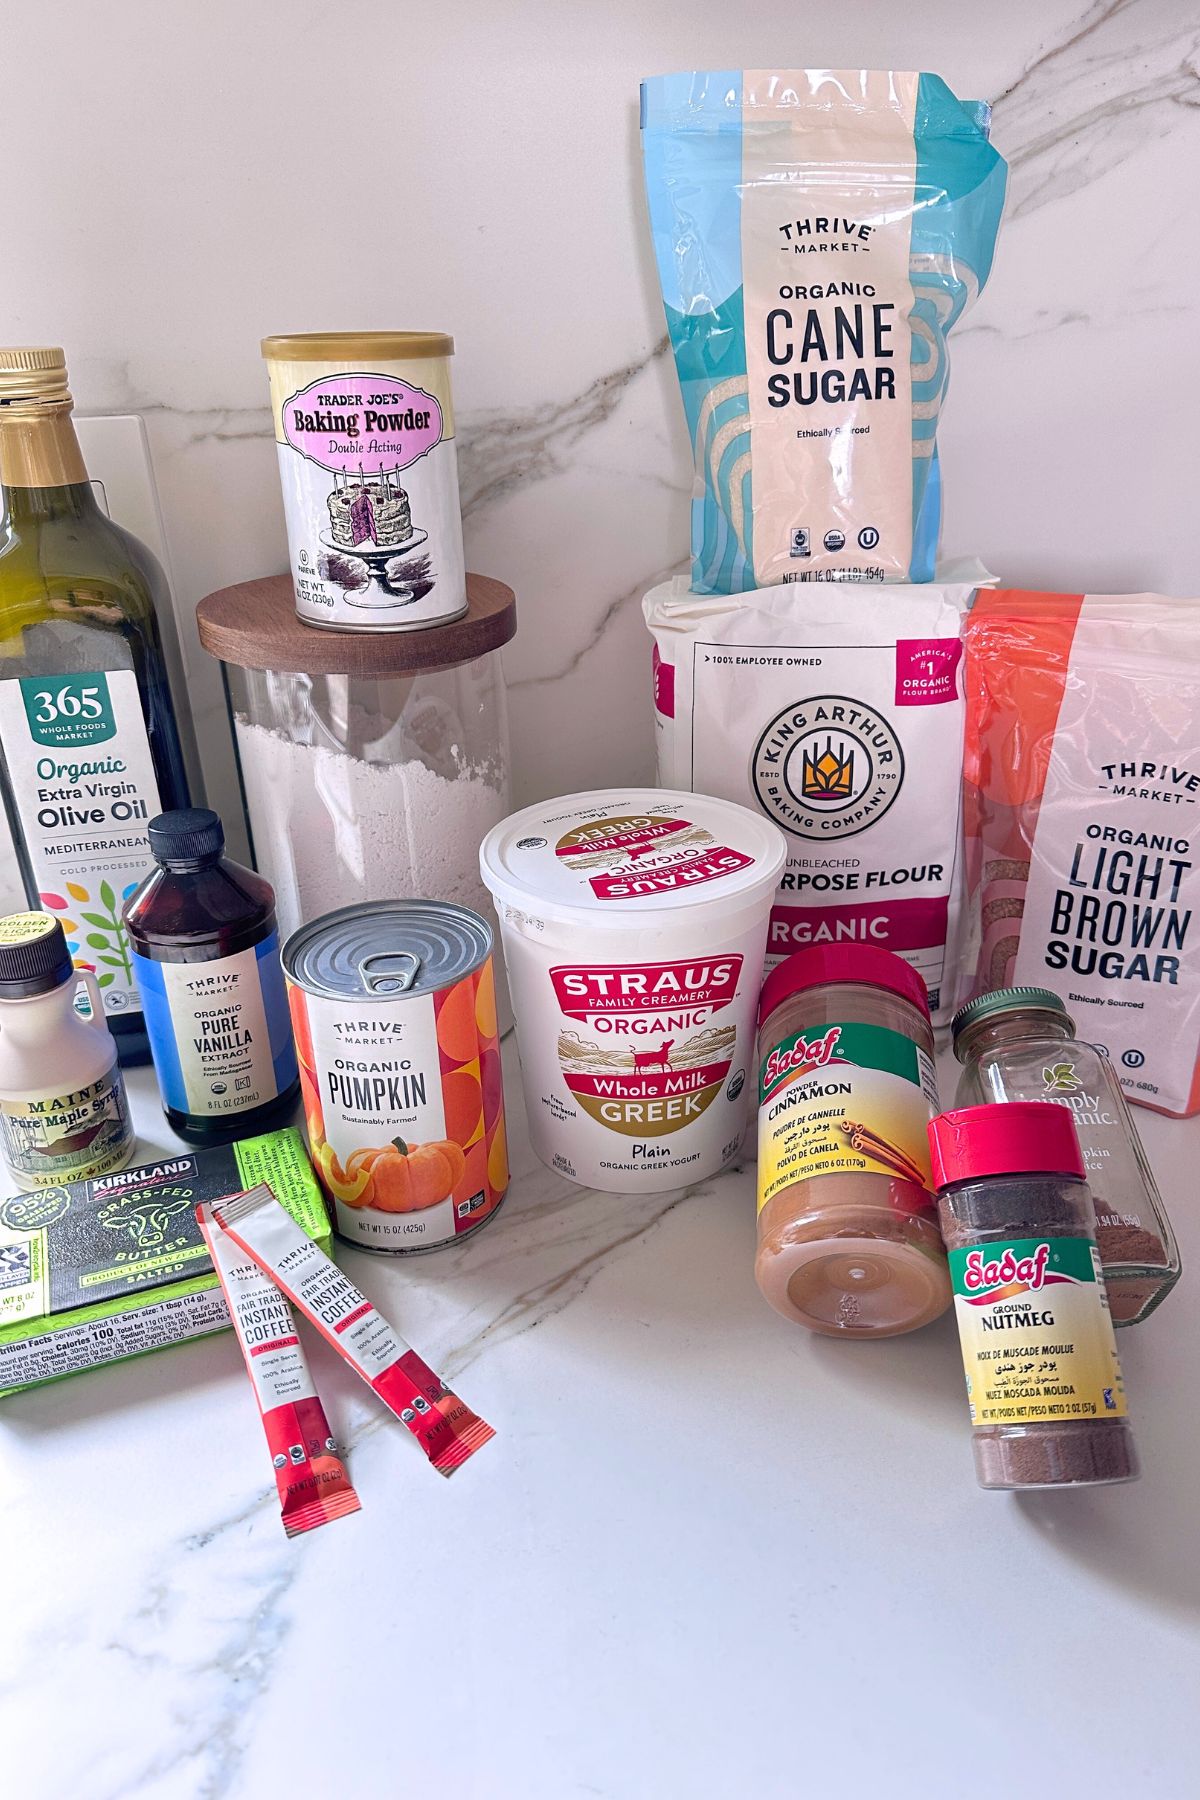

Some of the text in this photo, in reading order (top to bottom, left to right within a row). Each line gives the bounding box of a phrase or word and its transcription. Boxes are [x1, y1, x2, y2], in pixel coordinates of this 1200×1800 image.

[779, 217, 872, 242] THRIVE
[779, 282, 876, 300] ORGANIC
[766, 303, 894, 366] CANE
[768, 367, 896, 408] SUGAR
[317, 393, 399, 406] TRADER JOE'S
[294, 408, 430, 437] Baking Powder
[797, 429, 832, 438] Ethically
[328, 440, 402, 454] Double Acting
[310, 582, 325, 592] WT.
[312, 593, 334, 607] (230g)
[712, 656, 822, 666] 100% EMPLOYEE OWNED
[909, 650, 952, 662] AMERICA'S
[920, 660, 934, 675] #1
[903, 676, 950, 688] ORGANIC
[33, 685, 103, 723] 365
[39, 722, 106, 734] WHOLE FOODS
[56, 732, 93, 741] MARKET
[764, 706, 893, 765] KING ARTHUR
[37, 756, 127, 784] Organic
[1101, 763, 1200, 792] THRIVE
[38, 782, 137, 802] Extra Virgin
[1113, 785, 1183, 804] MARKET
[38, 799, 148, 828] Olive Oil
[768, 786, 887, 829] BAKING COMPANY
[570, 818, 653, 842] GREEK
[1086, 824, 1190, 854] ORGANIC
[45, 836, 151, 855] MEDITERRANEAN
[60, 861, 148, 875] COLD PROCESSED
[611, 850, 700, 875] ORGANIC
[786, 859, 860, 868] UNBLEACHED
[606, 855, 743, 896] STRAUS
[865, 864, 943, 888] FLOUR
[1069, 843, 1192, 903] LIGHT
[772, 917, 889, 942] RGANIC
[1050, 890, 1192, 951] BROWN
[1045, 940, 1180, 985] SUGAR
[186, 974, 240, 990] THRIVE
[563, 963, 733, 996] STRAUS
[196, 985, 233, 997] MARKET
[589, 989, 712, 1008] FAMILY CREAMERY
[1068, 992, 1144, 1010] Ethically Sourced
[194, 1004, 242, 1019] ORGANIC
[201, 1015, 240, 1036] PURE
[334, 1021, 403, 1034] THRIVE
[594, 1009, 707, 1035] ORGANIC
[194, 1029, 252, 1054] VANILLA
[345, 1037, 394, 1045] MARKET
[201, 1047, 250, 1062] EXTRACT
[764, 1026, 842, 1090] Sadaf
[335, 1059, 412, 1072] ORGANIC
[328, 1071, 427, 1111] PUMPKIN
[593, 1078, 658, 1097] Whole
[665, 1072, 707, 1093] Milk
[786, 1081, 818, 1097] POWDER
[1136, 1082, 1159, 1094] 680g
[10, 1084, 119, 1128] Pure Maple Syrup
[28, 1080, 105, 1113] MAINE
[214, 1092, 259, 1108] FL OZ (237mL)
[768, 1083, 852, 1121] CINNAMON
[600, 1093, 702, 1123] GREEK
[342, 1114, 417, 1125] Sustainably Farmed
[772, 1108, 846, 1140] POUDRE DE CANNELLE
[812, 1123, 830, 1136] پودر
[632, 1144, 671, 1158] Plain
[777, 1143, 839, 1171] POLVO DE CANELA
[600, 1153, 701, 1171] ORGANIC GREEK YOGURT
[815, 1159, 866, 1170] NETO (170g)
[67, 1172, 84, 1181] OZ
[92, 1160, 192, 1191] KIRKLAND
[10, 1190, 56, 1217] 95%
[97, 1188, 193, 1219] GRASS-FED
[27, 1206, 59, 1225] BUTTER
[358, 1222, 426, 1235] NET WT (425g)
[115, 1236, 189, 1261] BUTTER
[278, 1242, 316, 1269] THRIVE
[86, 1265, 135, 1283] PRODUCT
[127, 1264, 185, 1283] SALTED
[301, 1264, 331, 1287] ORGANIC
[964, 1243, 1050, 1291] Sadaf
[240, 1286, 277, 1300] ORGANIC
[301, 1284, 320, 1300] FAIR
[309, 1277, 352, 1312] INSTANT
[237, 1293, 286, 1313] FAIR TRADE
[321, 1288, 366, 1324] COFFEE
[993, 1303, 1032, 1314] GROUND
[29, 1300, 182, 1347] Facts Servings: About Serv. size: tbsp
[240, 1303, 289, 1329] INSTANT
[342, 1305, 369, 1327] ORIGINAL
[982, 1311, 1055, 1332] NUTMEG
[68, 1317, 215, 1362] Sugars Protein
[245, 1319, 295, 1345] COFFEE
[371, 1325, 389, 1341] Arabica
[42, 1330, 145, 1362] Cholest. Sodium
[56, 1337, 91, 1351] Calories
[258, 1340, 292, 1352] ORIGINAL
[993, 1345, 1074, 1359] DE MUSCADE MOULUE
[261, 1358, 279, 1366] Single
[280, 1365, 303, 1374] Arabica
[1038, 1362, 1057, 1372] پودر
[986, 1385, 1075, 1400] NUEZ MOSCADA MOLIDA
[1082, 1403, 1097, 1414] (57g)
